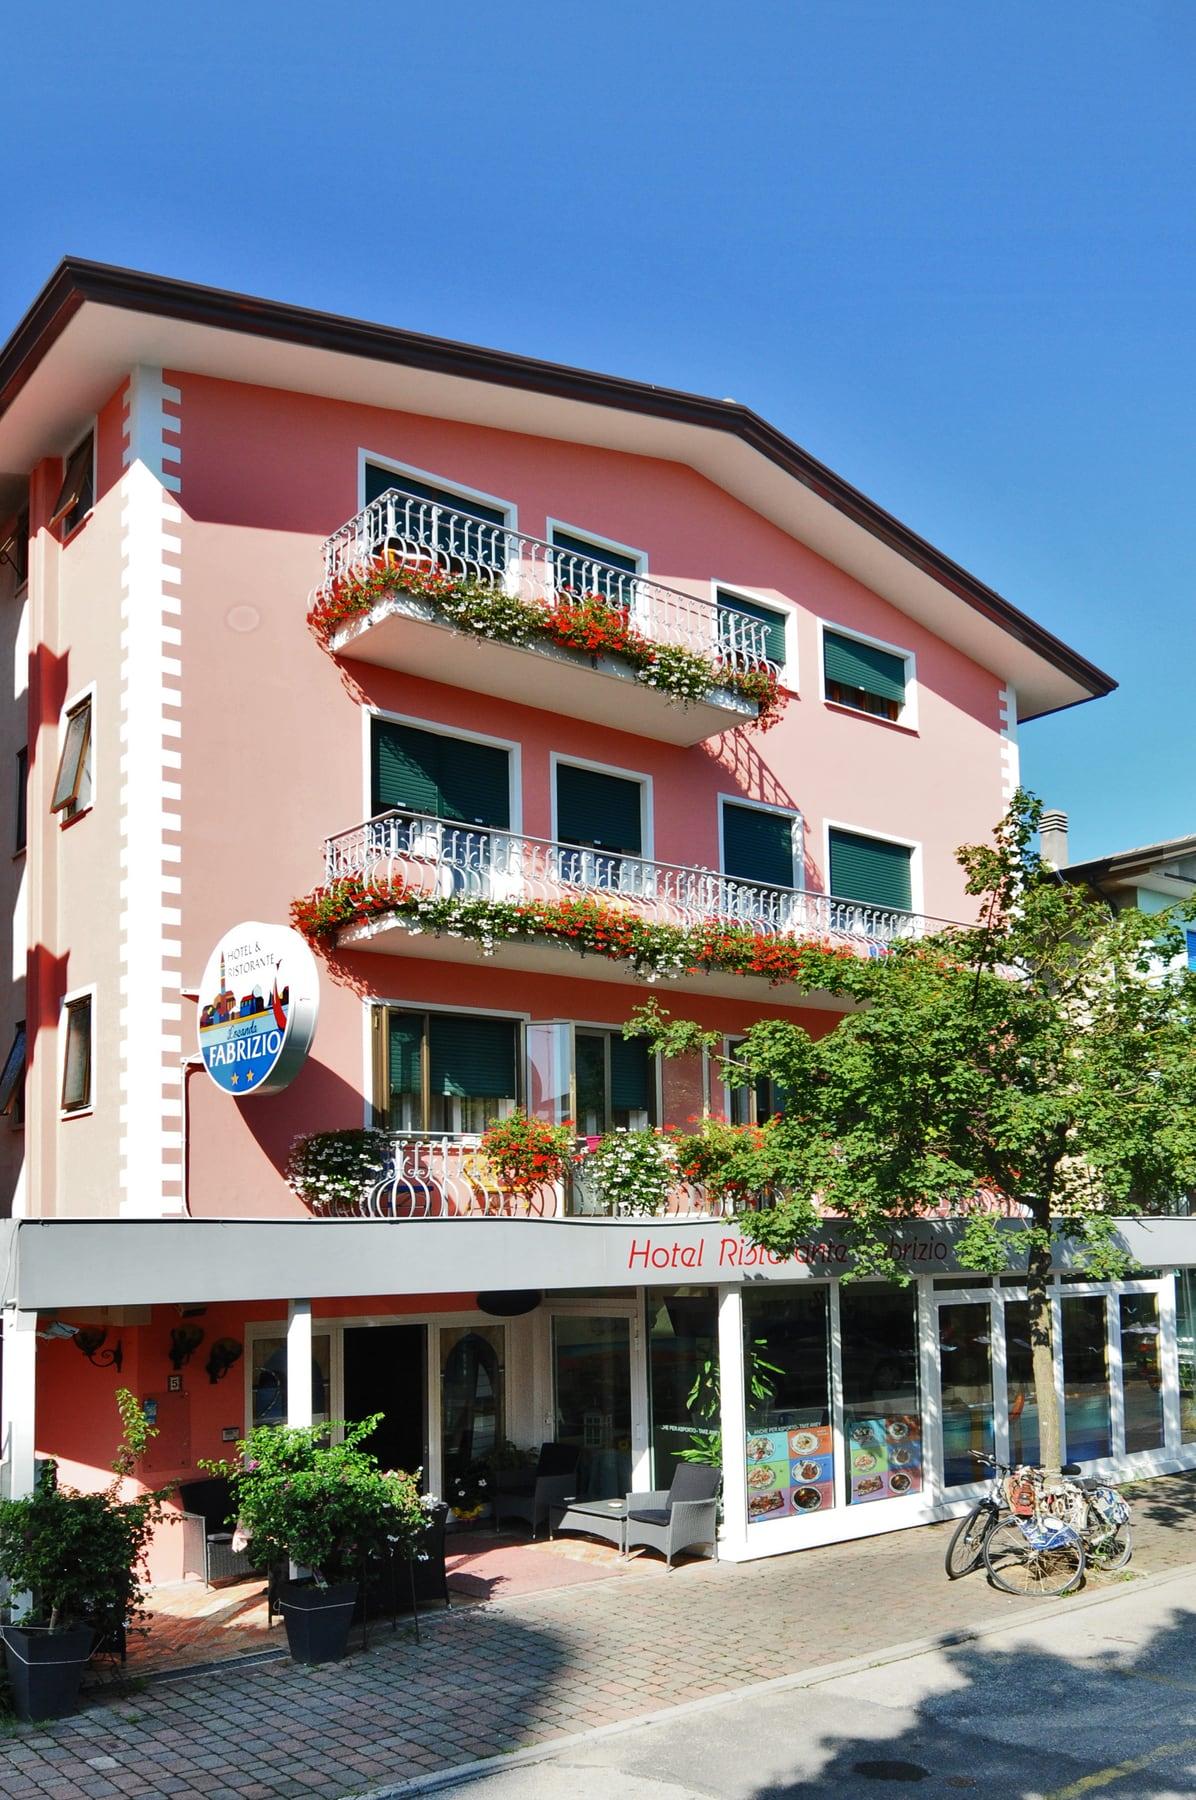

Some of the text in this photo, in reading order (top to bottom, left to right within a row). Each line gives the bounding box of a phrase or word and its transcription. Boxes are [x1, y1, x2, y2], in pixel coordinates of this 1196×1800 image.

[227, 941, 261, 960] HOTEL &
[227, 952, 275, 976] RISTORANTE
[209, 1030, 281, 1068] FABRIZIO
[628, 1238, 704, 1268] Hotel
